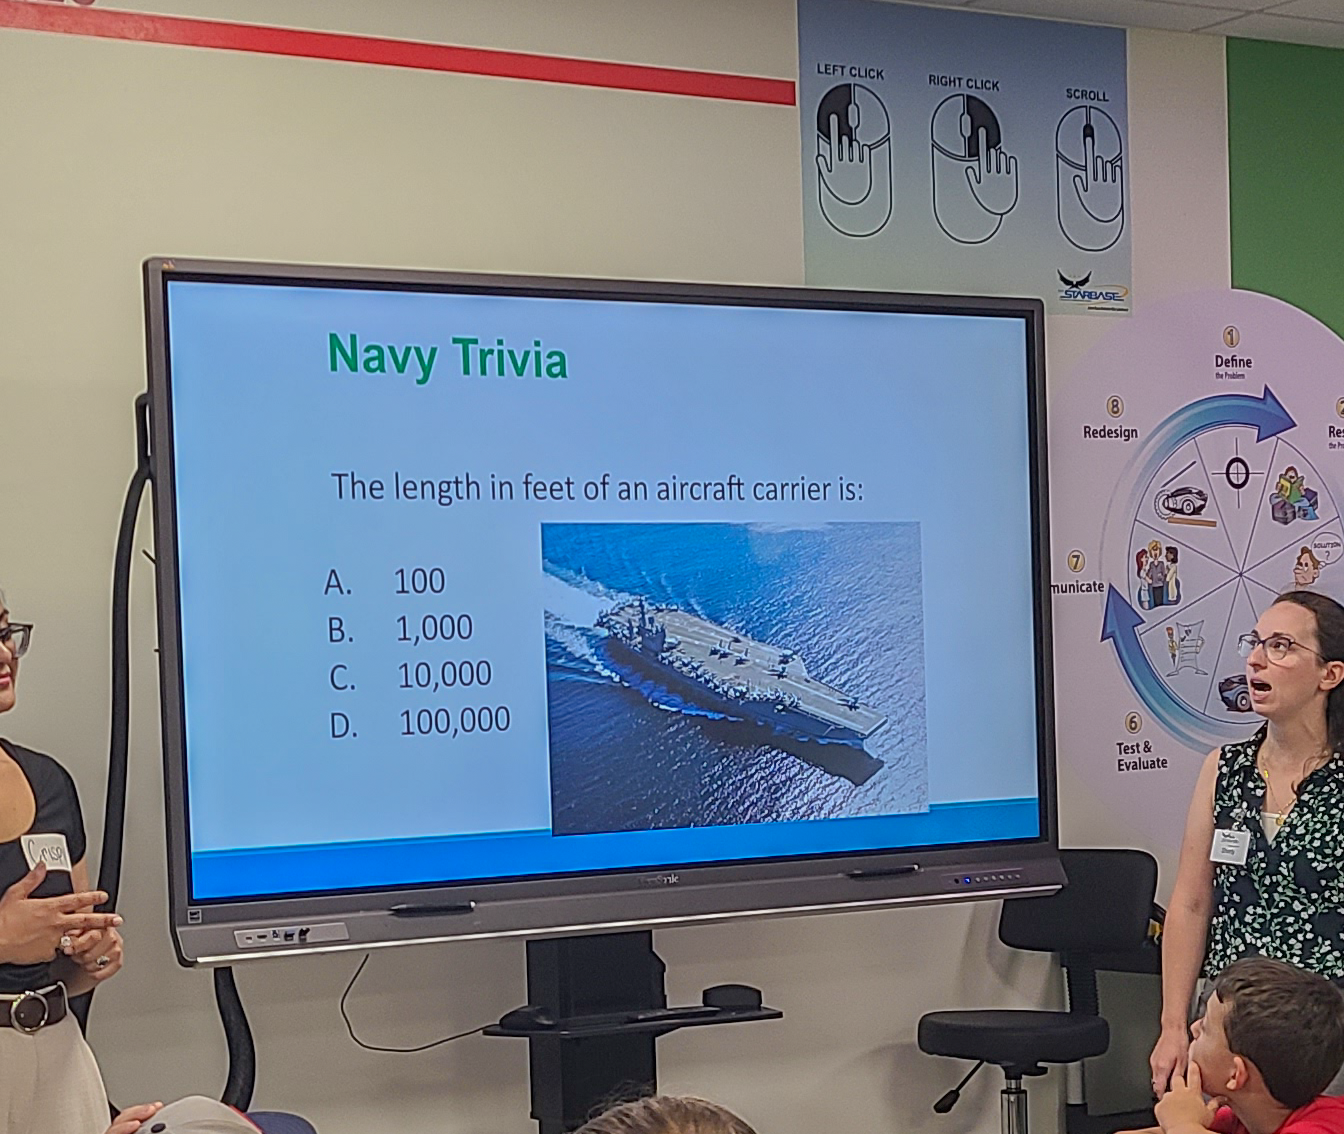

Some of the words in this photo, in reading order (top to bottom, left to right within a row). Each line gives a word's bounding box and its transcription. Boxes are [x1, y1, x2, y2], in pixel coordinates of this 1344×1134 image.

[817, 63, 846, 77] LEFT
[849, 66, 884, 80] CLICK
[928, 74, 963, 89] RIGHT
[966, 77, 1000, 92] CLICK
[1066, 88, 1109, 102] SCROLL
[1060, 288, 1124, 301] STARBASE
[328, 332, 439, 385] Navy
[452, 337, 568, 379] Trivia
[1215, 355, 1252, 368] Define
[1224, 372, 1245, 380] Problem
[1083, 424, 1138, 442] Redesign
[331, 473, 384, 499] The
[395, 472, 480, 506] length
[491, 473, 513, 500] in
[523, 473, 575, 500] feet
[584, 473, 609, 500] of
[618, 479, 648, 500] an
[656, 474, 744, 501] aircraft
[753, 476, 829, 501] carrier
[840, 475, 863, 501] is:
[324, 569, 351, 595] A.
[395, 568, 445, 594] 100
[329, 617, 353, 642] B.
[397, 614, 472, 646] 1,000
[331, 665, 355, 690] C.
[399, 660, 491, 692] 10,000
[331, 712, 357, 738] D.
[401, 706, 510, 739] 100,000
[1116, 742, 1140, 755] Test
[1143, 741, 1152, 753] &
[1118, 757, 1168, 772] Evaluate
